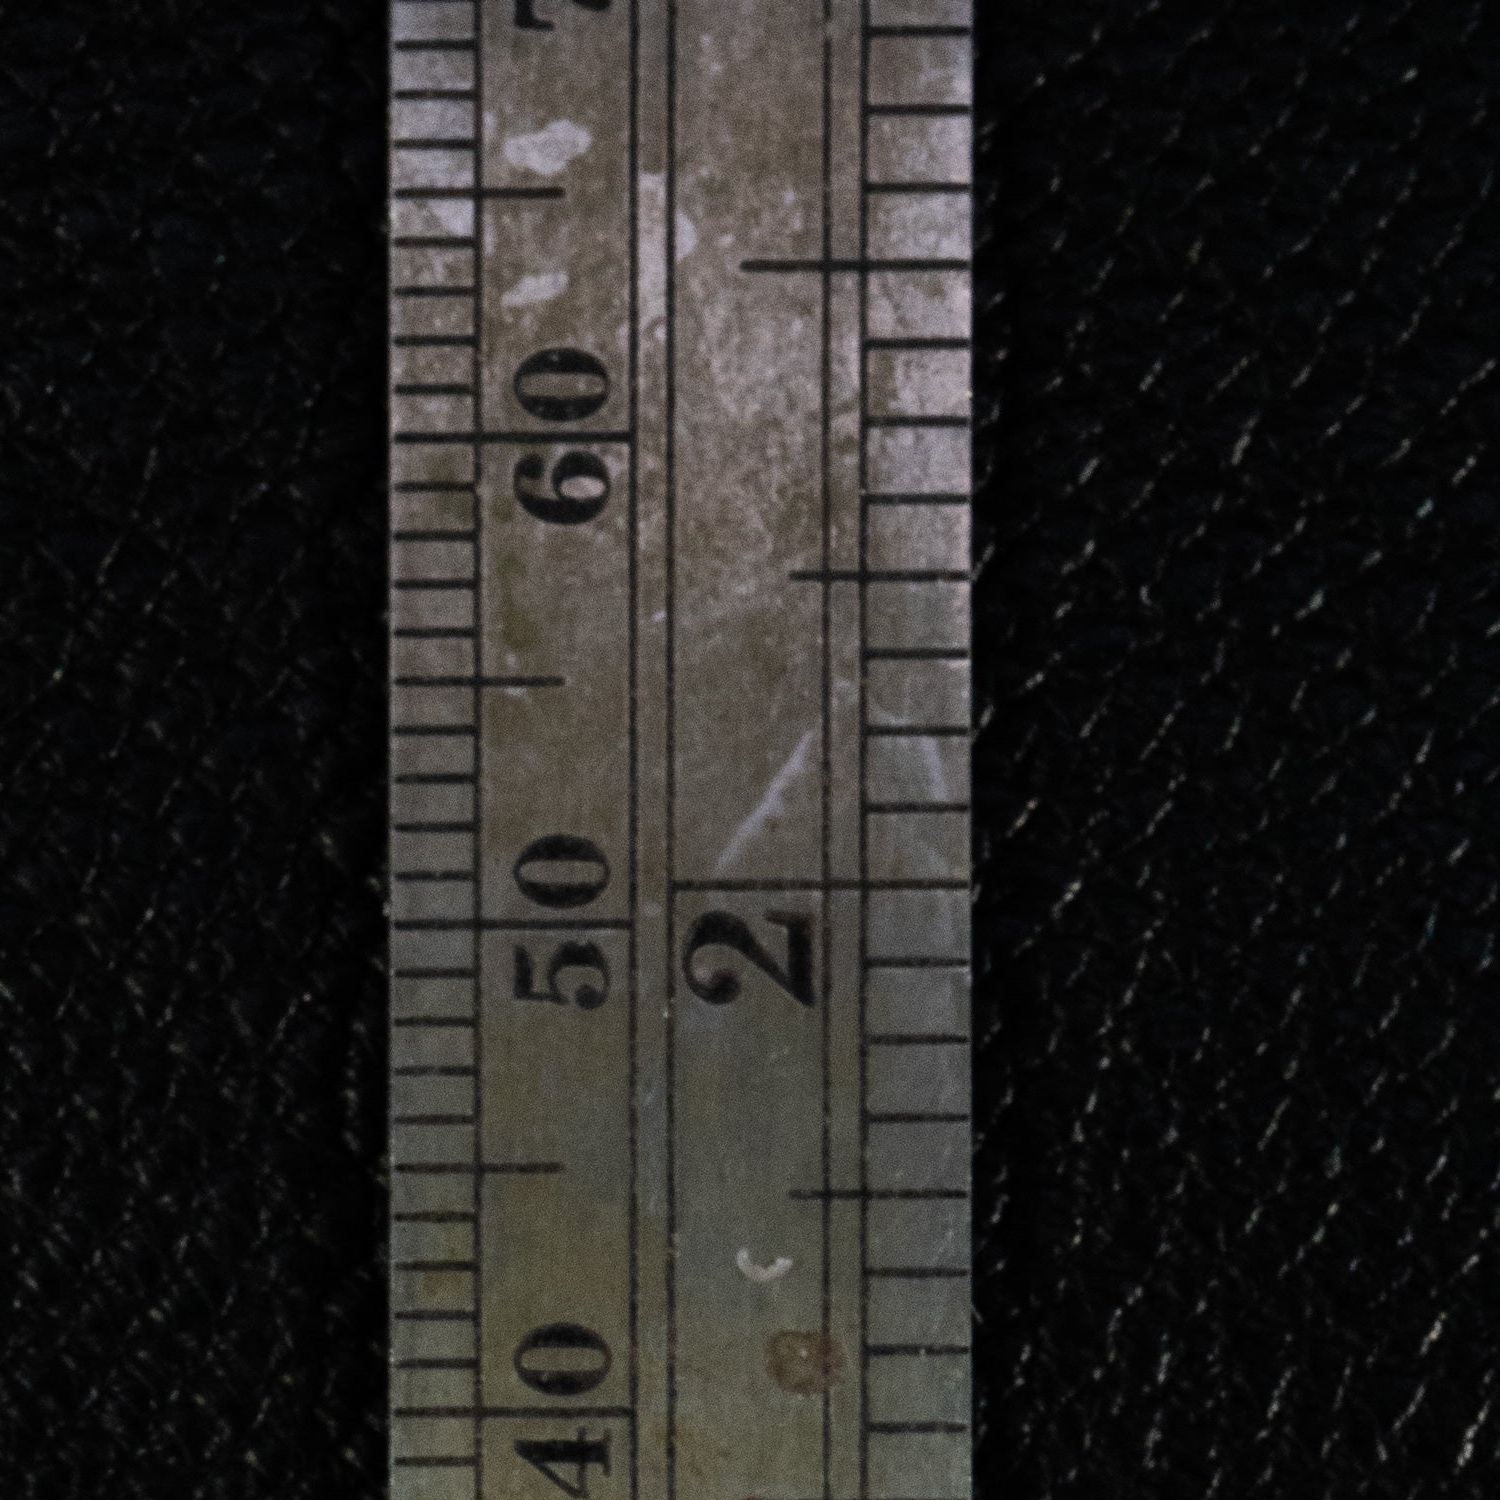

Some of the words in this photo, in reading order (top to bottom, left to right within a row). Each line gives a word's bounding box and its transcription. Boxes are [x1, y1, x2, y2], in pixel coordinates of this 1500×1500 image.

[513, 347, 610, 525] 60
[513, 834, 611, 1009] 50
[683, 910, 816, 1008] 2
[514, 1322, 613, 1500] 40
